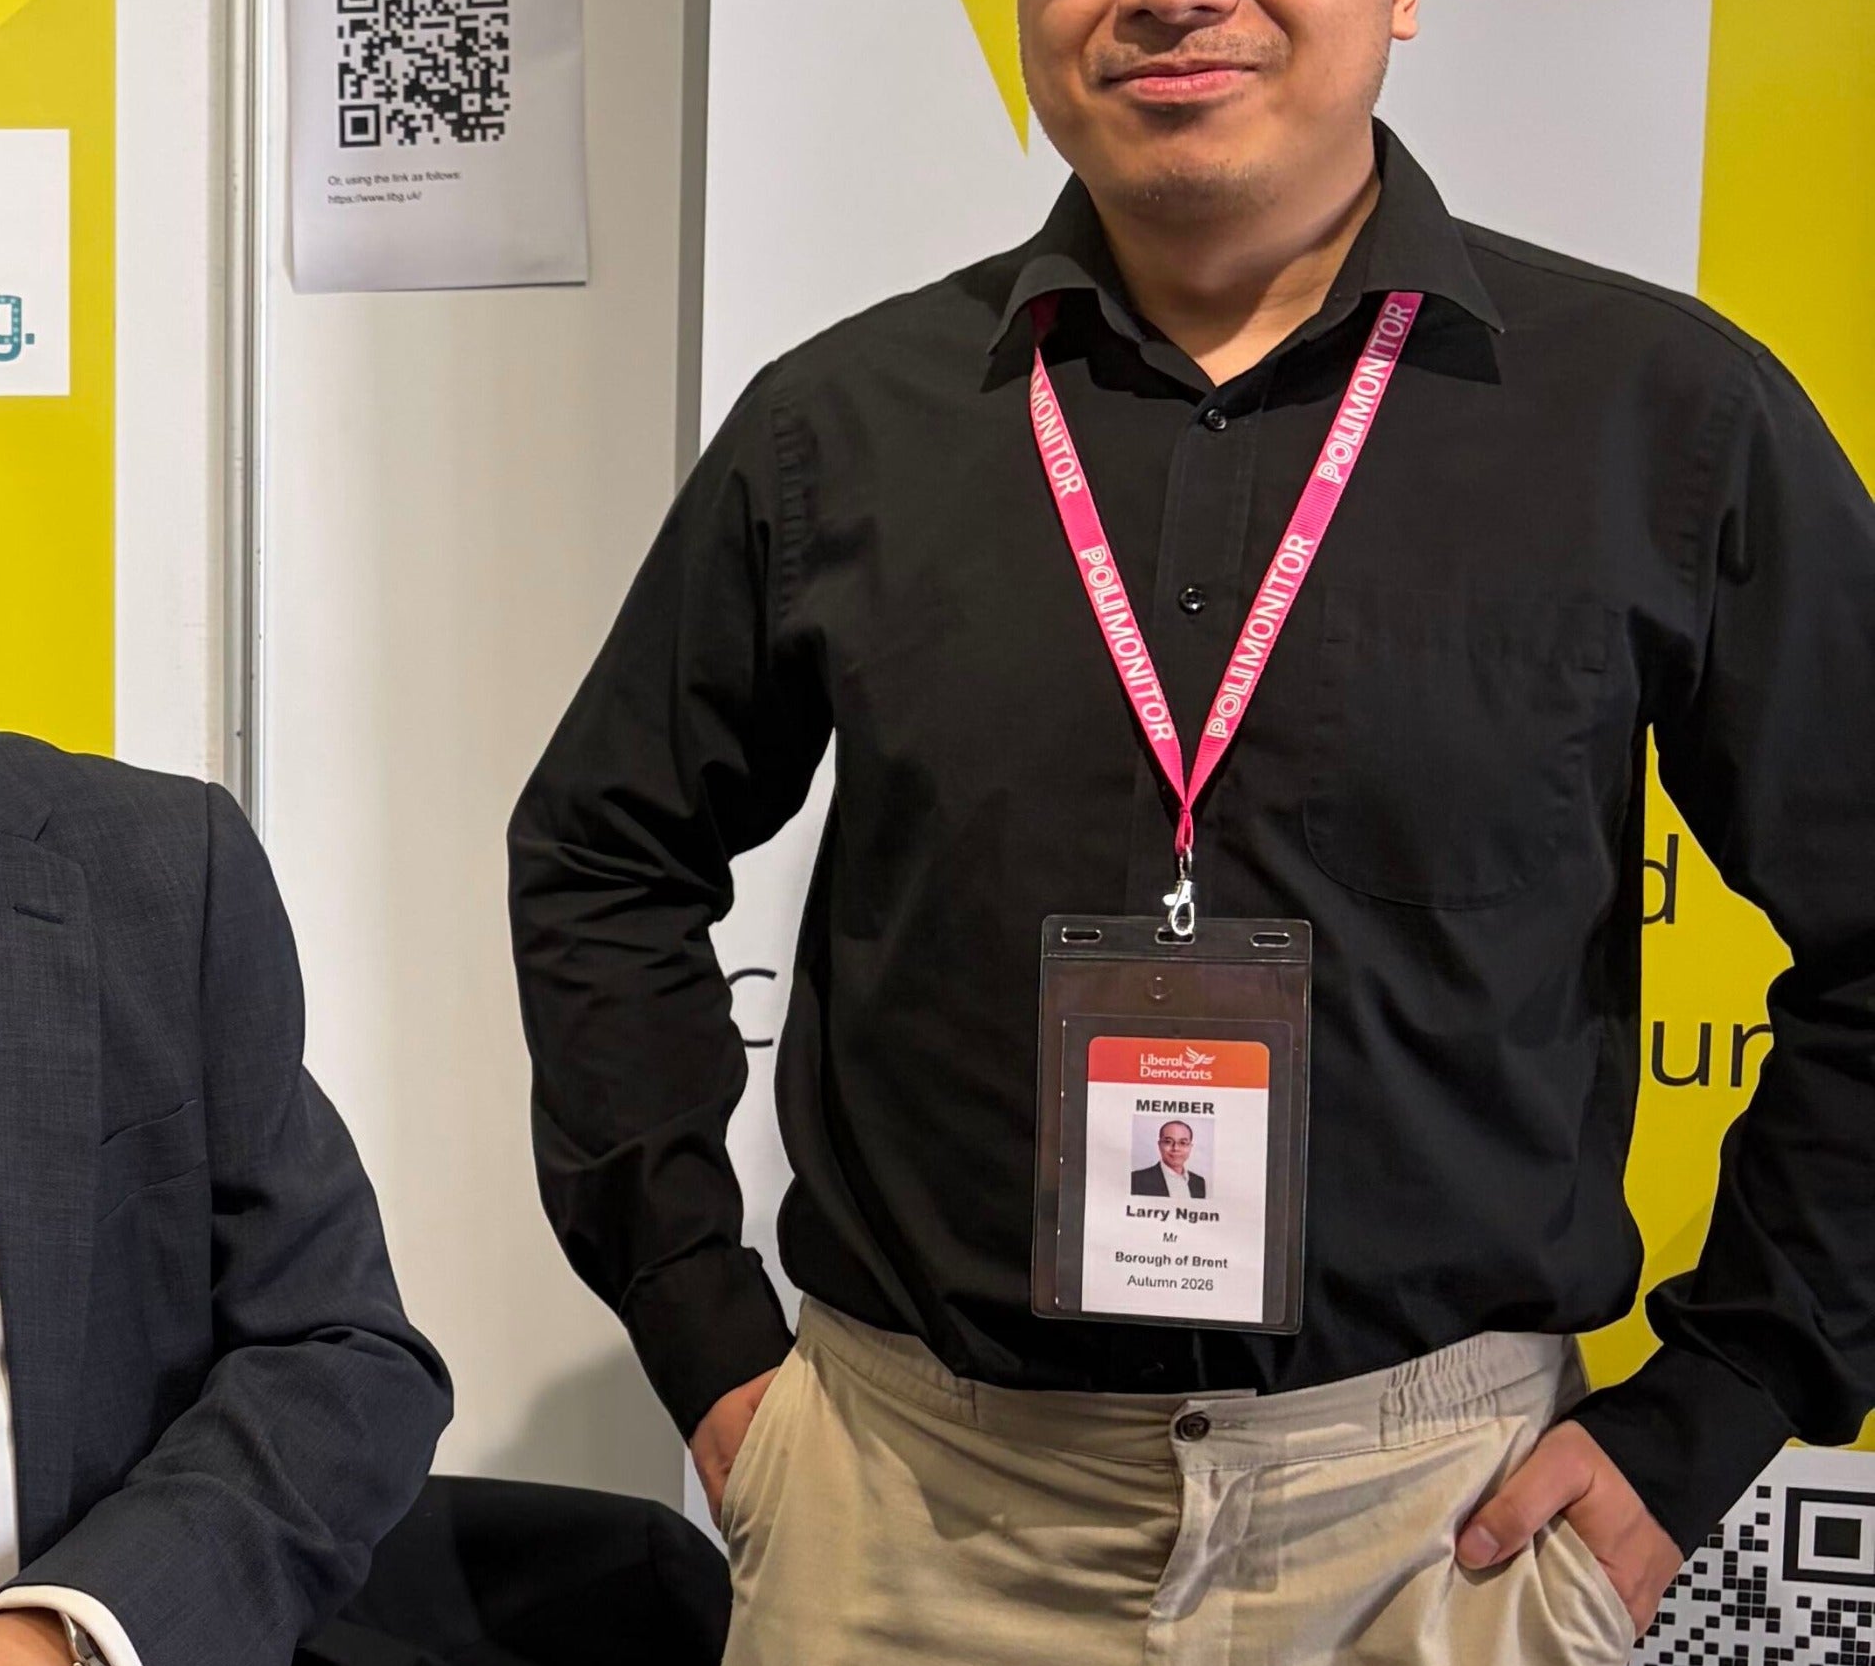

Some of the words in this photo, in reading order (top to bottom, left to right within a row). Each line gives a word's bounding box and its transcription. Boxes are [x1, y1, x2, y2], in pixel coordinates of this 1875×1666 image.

[1317, 302, 1412, 484] POLIMONITOR
[1080, 546, 1174, 742] POLIMONITOR
[1207, 534, 1314, 739] POLIMONITOR
[1140, 1053, 1184, 1067] Liberal
[1140, 1066, 1213, 1081] Democrats
[1136, 1099, 1214, 1114] MEMBER
[1126, 1205, 1170, 1221] Larry
[1176, 1207, 1219, 1224] Ngan
[1163, 1232, 1177, 1242] Mr
[1115, 1251, 1171, 1267] Borough
[1175, 1255, 1188, 1266] of
[1192, 1256, 1227, 1268] Brent
[1127, 1275, 1177, 1288] Autumn
[1181, 1278, 1213, 1291] 2026
